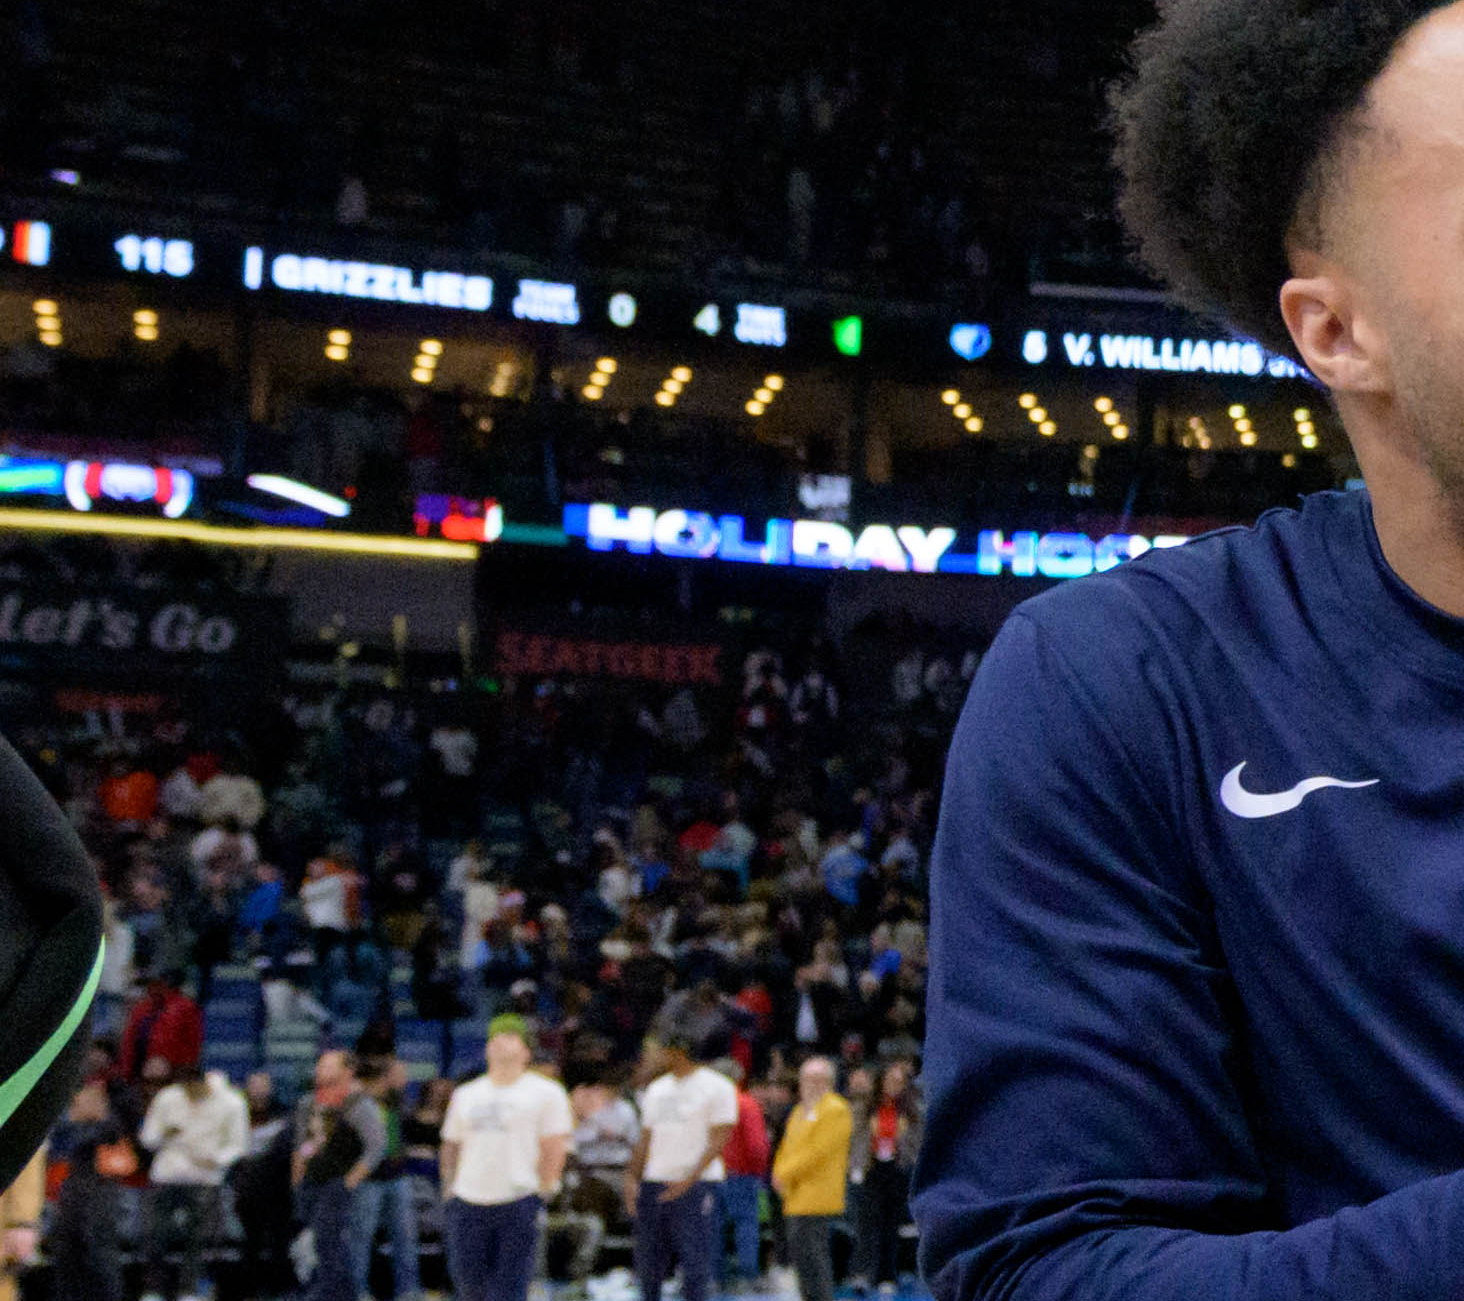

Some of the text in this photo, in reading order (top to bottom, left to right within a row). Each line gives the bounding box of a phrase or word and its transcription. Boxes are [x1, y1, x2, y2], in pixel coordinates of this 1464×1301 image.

[271, 253, 494, 312] GRIZZLIES
[1062, 332, 1095, 367] V.
[1100, 334, 1266, 377] WILLIAMS
[587, 502, 1191, 580] HOLIDAY HOO
[149, 601, 237, 653] Go
